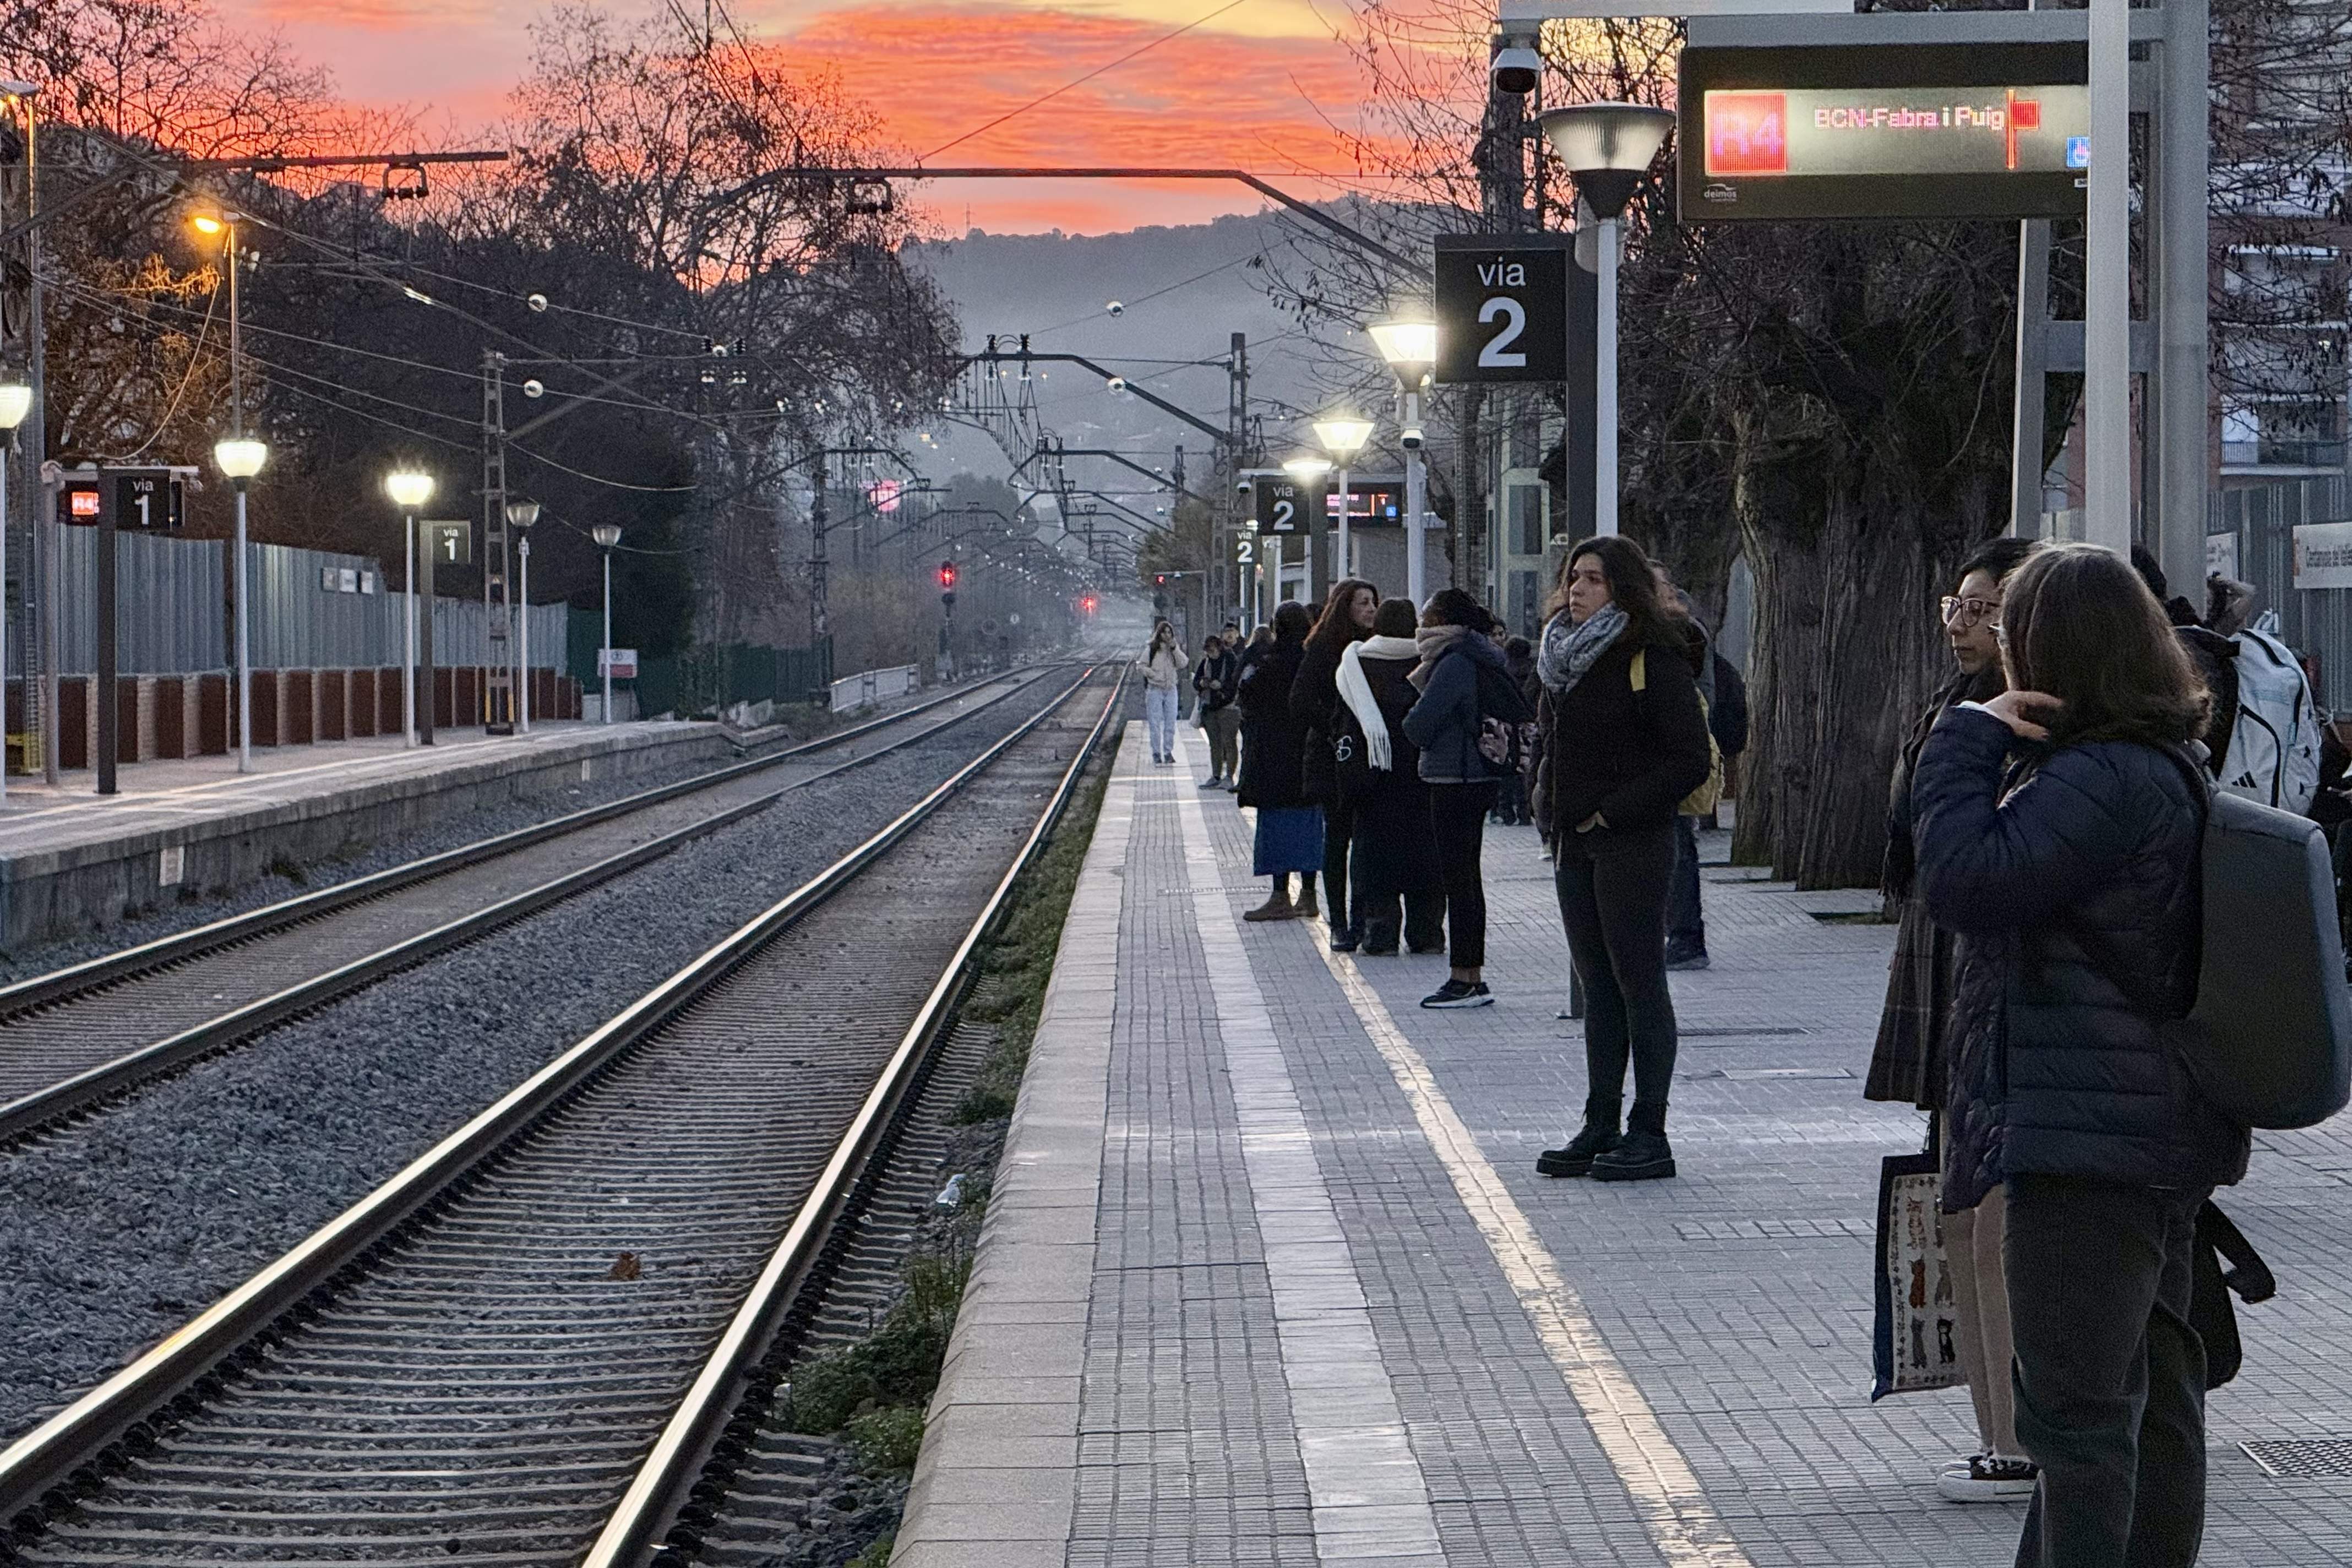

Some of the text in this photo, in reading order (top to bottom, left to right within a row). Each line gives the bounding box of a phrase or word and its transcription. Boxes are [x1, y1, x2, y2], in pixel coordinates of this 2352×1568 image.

[1815, 106, 2004, 130] BCN-Fabra i Puig
[1713, 112, 1784, 155] R4
[1704, 189, 1736, 199] deimos
[1477, 256, 1526, 286] via
[1478, 296, 1526, 367] 2
[133, 478, 154, 492] via
[1273, 483, 1294, 497] via
[135, 494, 149, 525] 1
[1273, 500, 1294, 530] 2
[443, 527, 458, 537] via
[1237, 530, 1252, 540] via
[444, 538, 455, 560] 1
[1237, 541, 1253, 563] 2
